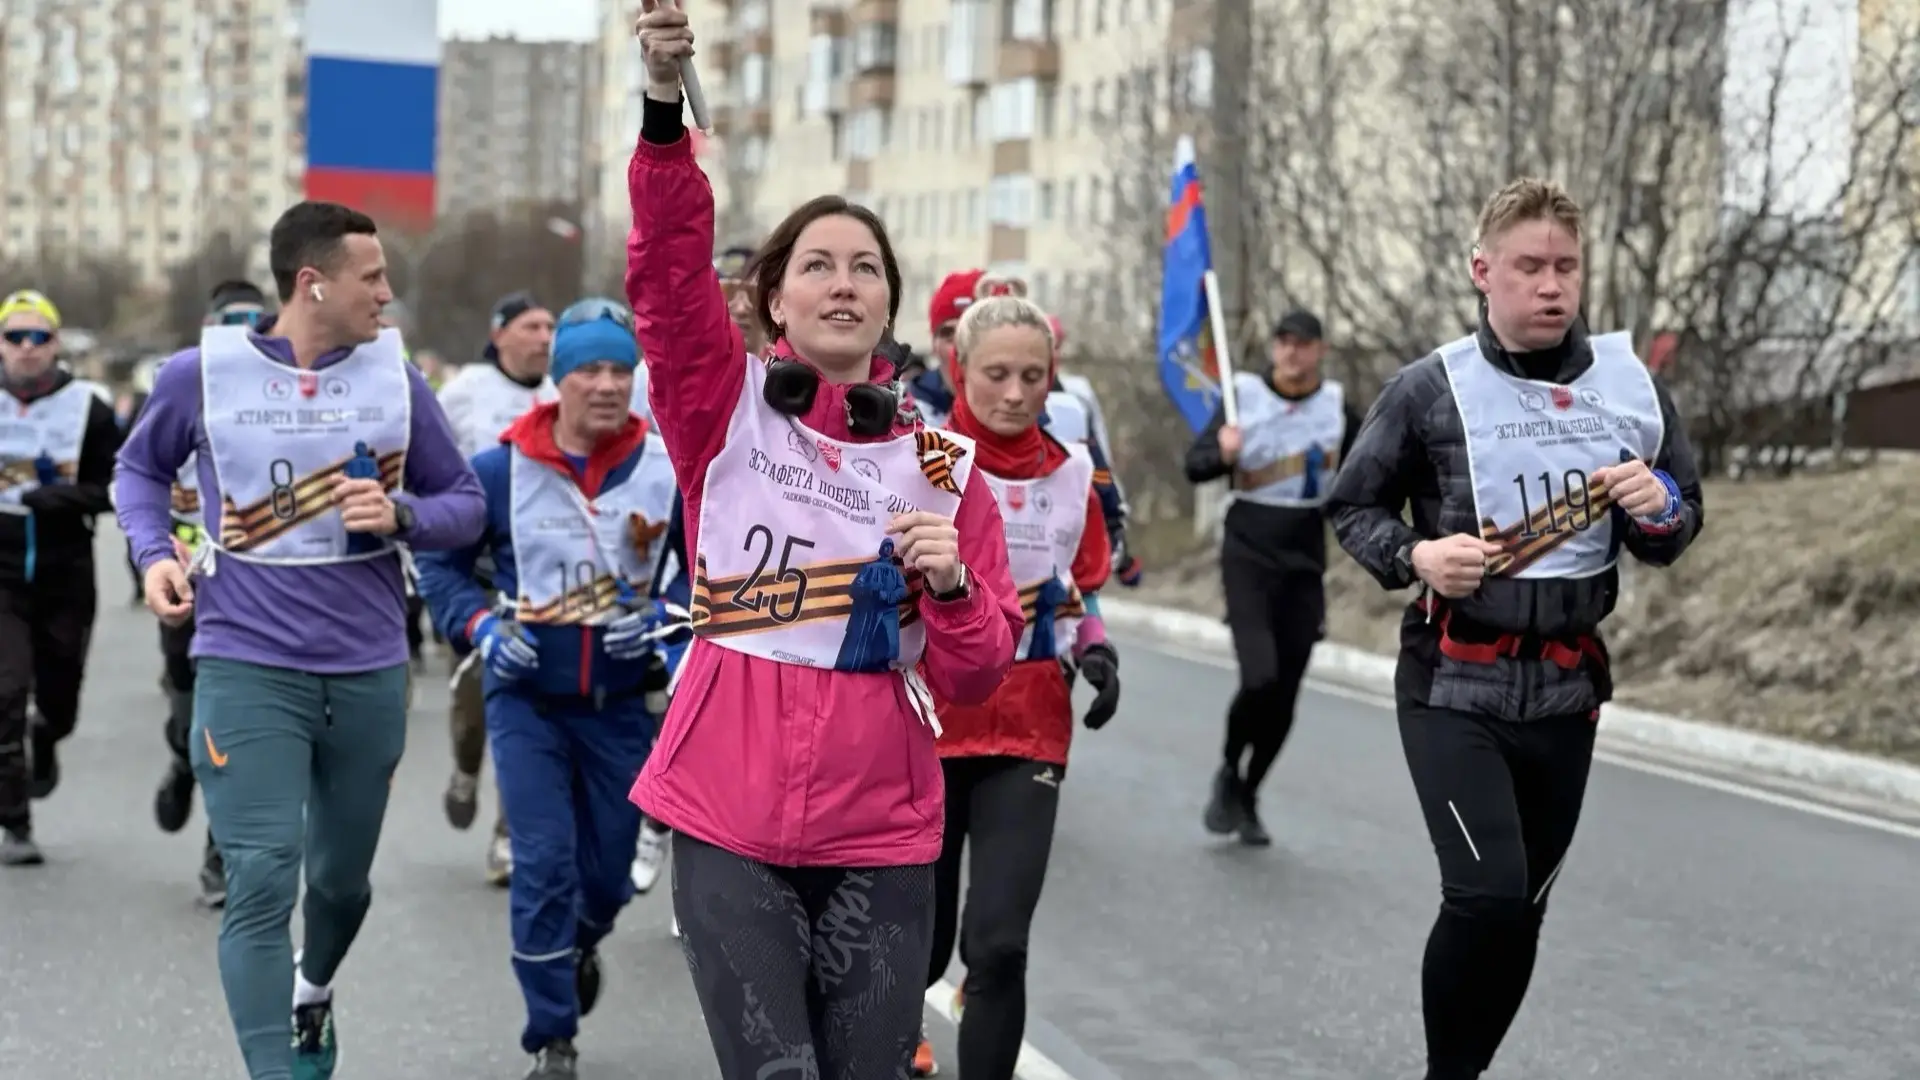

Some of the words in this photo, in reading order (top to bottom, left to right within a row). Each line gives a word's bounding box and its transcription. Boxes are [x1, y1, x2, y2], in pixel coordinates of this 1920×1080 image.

[1495, 420, 1555, 440] ЭСТАФЕТА
[270, 458, 296, 520] 8
[749, 448, 814, 490] ЭСТАФЕТА
[818, 479, 871, 511] ПОБЕДЫ
[887, 494, 921, 514] 202
[1513, 469, 1591, 537] 119
[732, 524, 815, 624] 25
